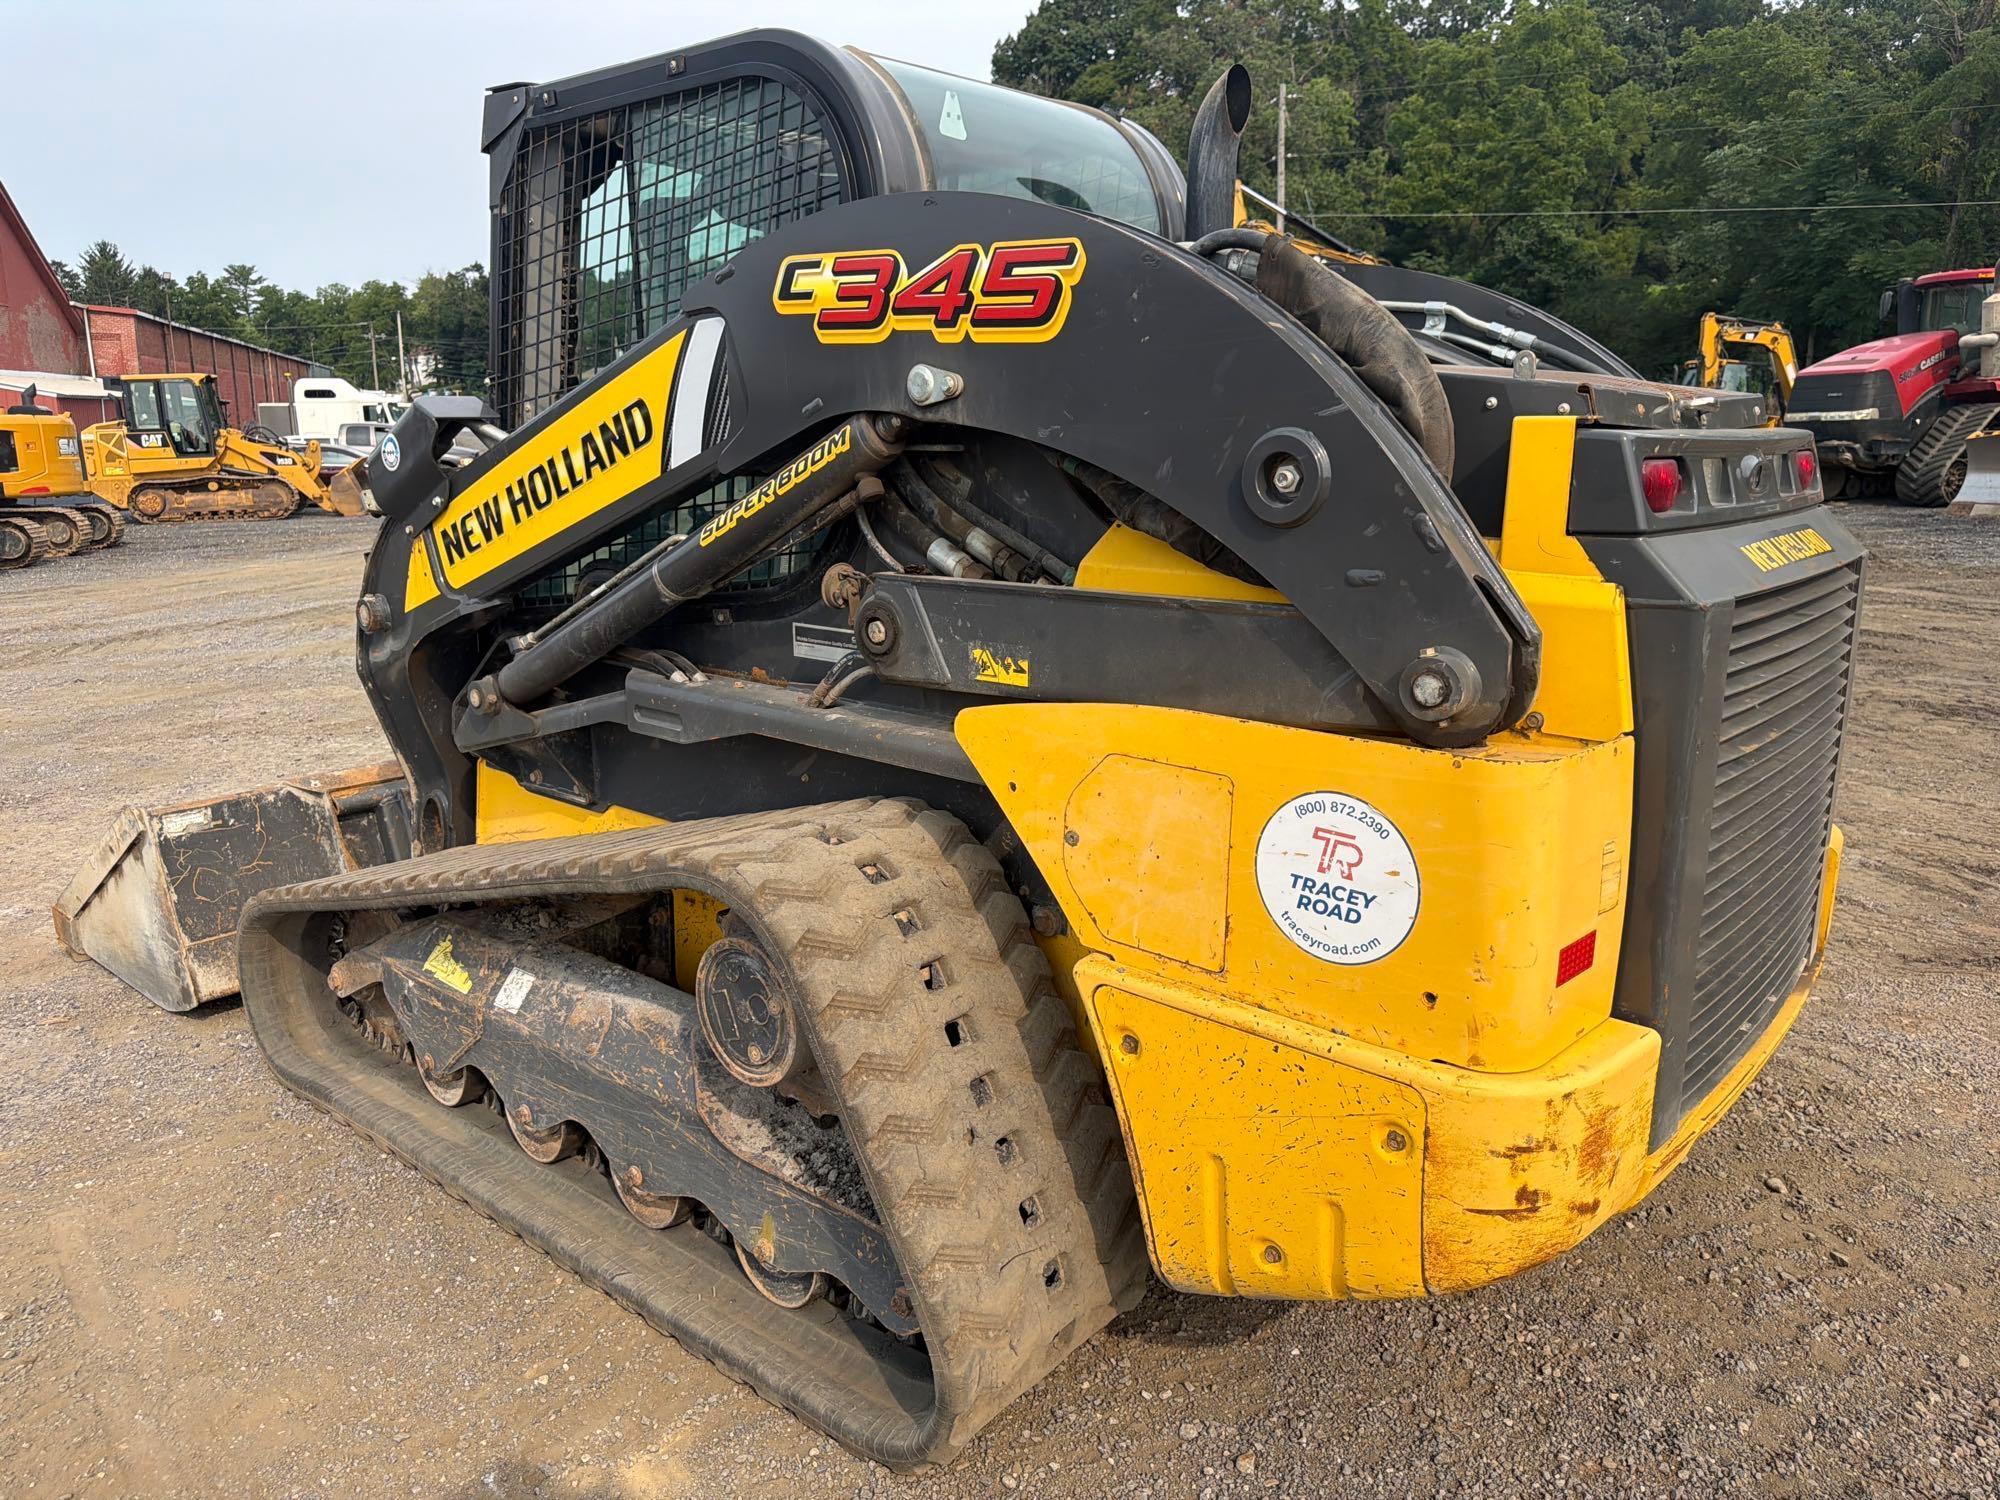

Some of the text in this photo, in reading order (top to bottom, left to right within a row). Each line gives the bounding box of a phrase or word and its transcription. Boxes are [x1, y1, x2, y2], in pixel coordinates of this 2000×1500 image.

[774, 240, 1084, 341] C345
[141, 434, 163, 447] CAT
[440, 397, 654, 567] NEW HOLLAND
[700, 425, 851, 547] SUPER BOOM
[1740, 528, 1833, 573] NEW HOLLAND
[1294, 799, 1391, 840] (800) 872.2390
[1290, 873, 1378, 909] TRACEY
[1296, 893, 1362, 925] ROAD
[1281, 910, 1381, 955] traceyroad.com
